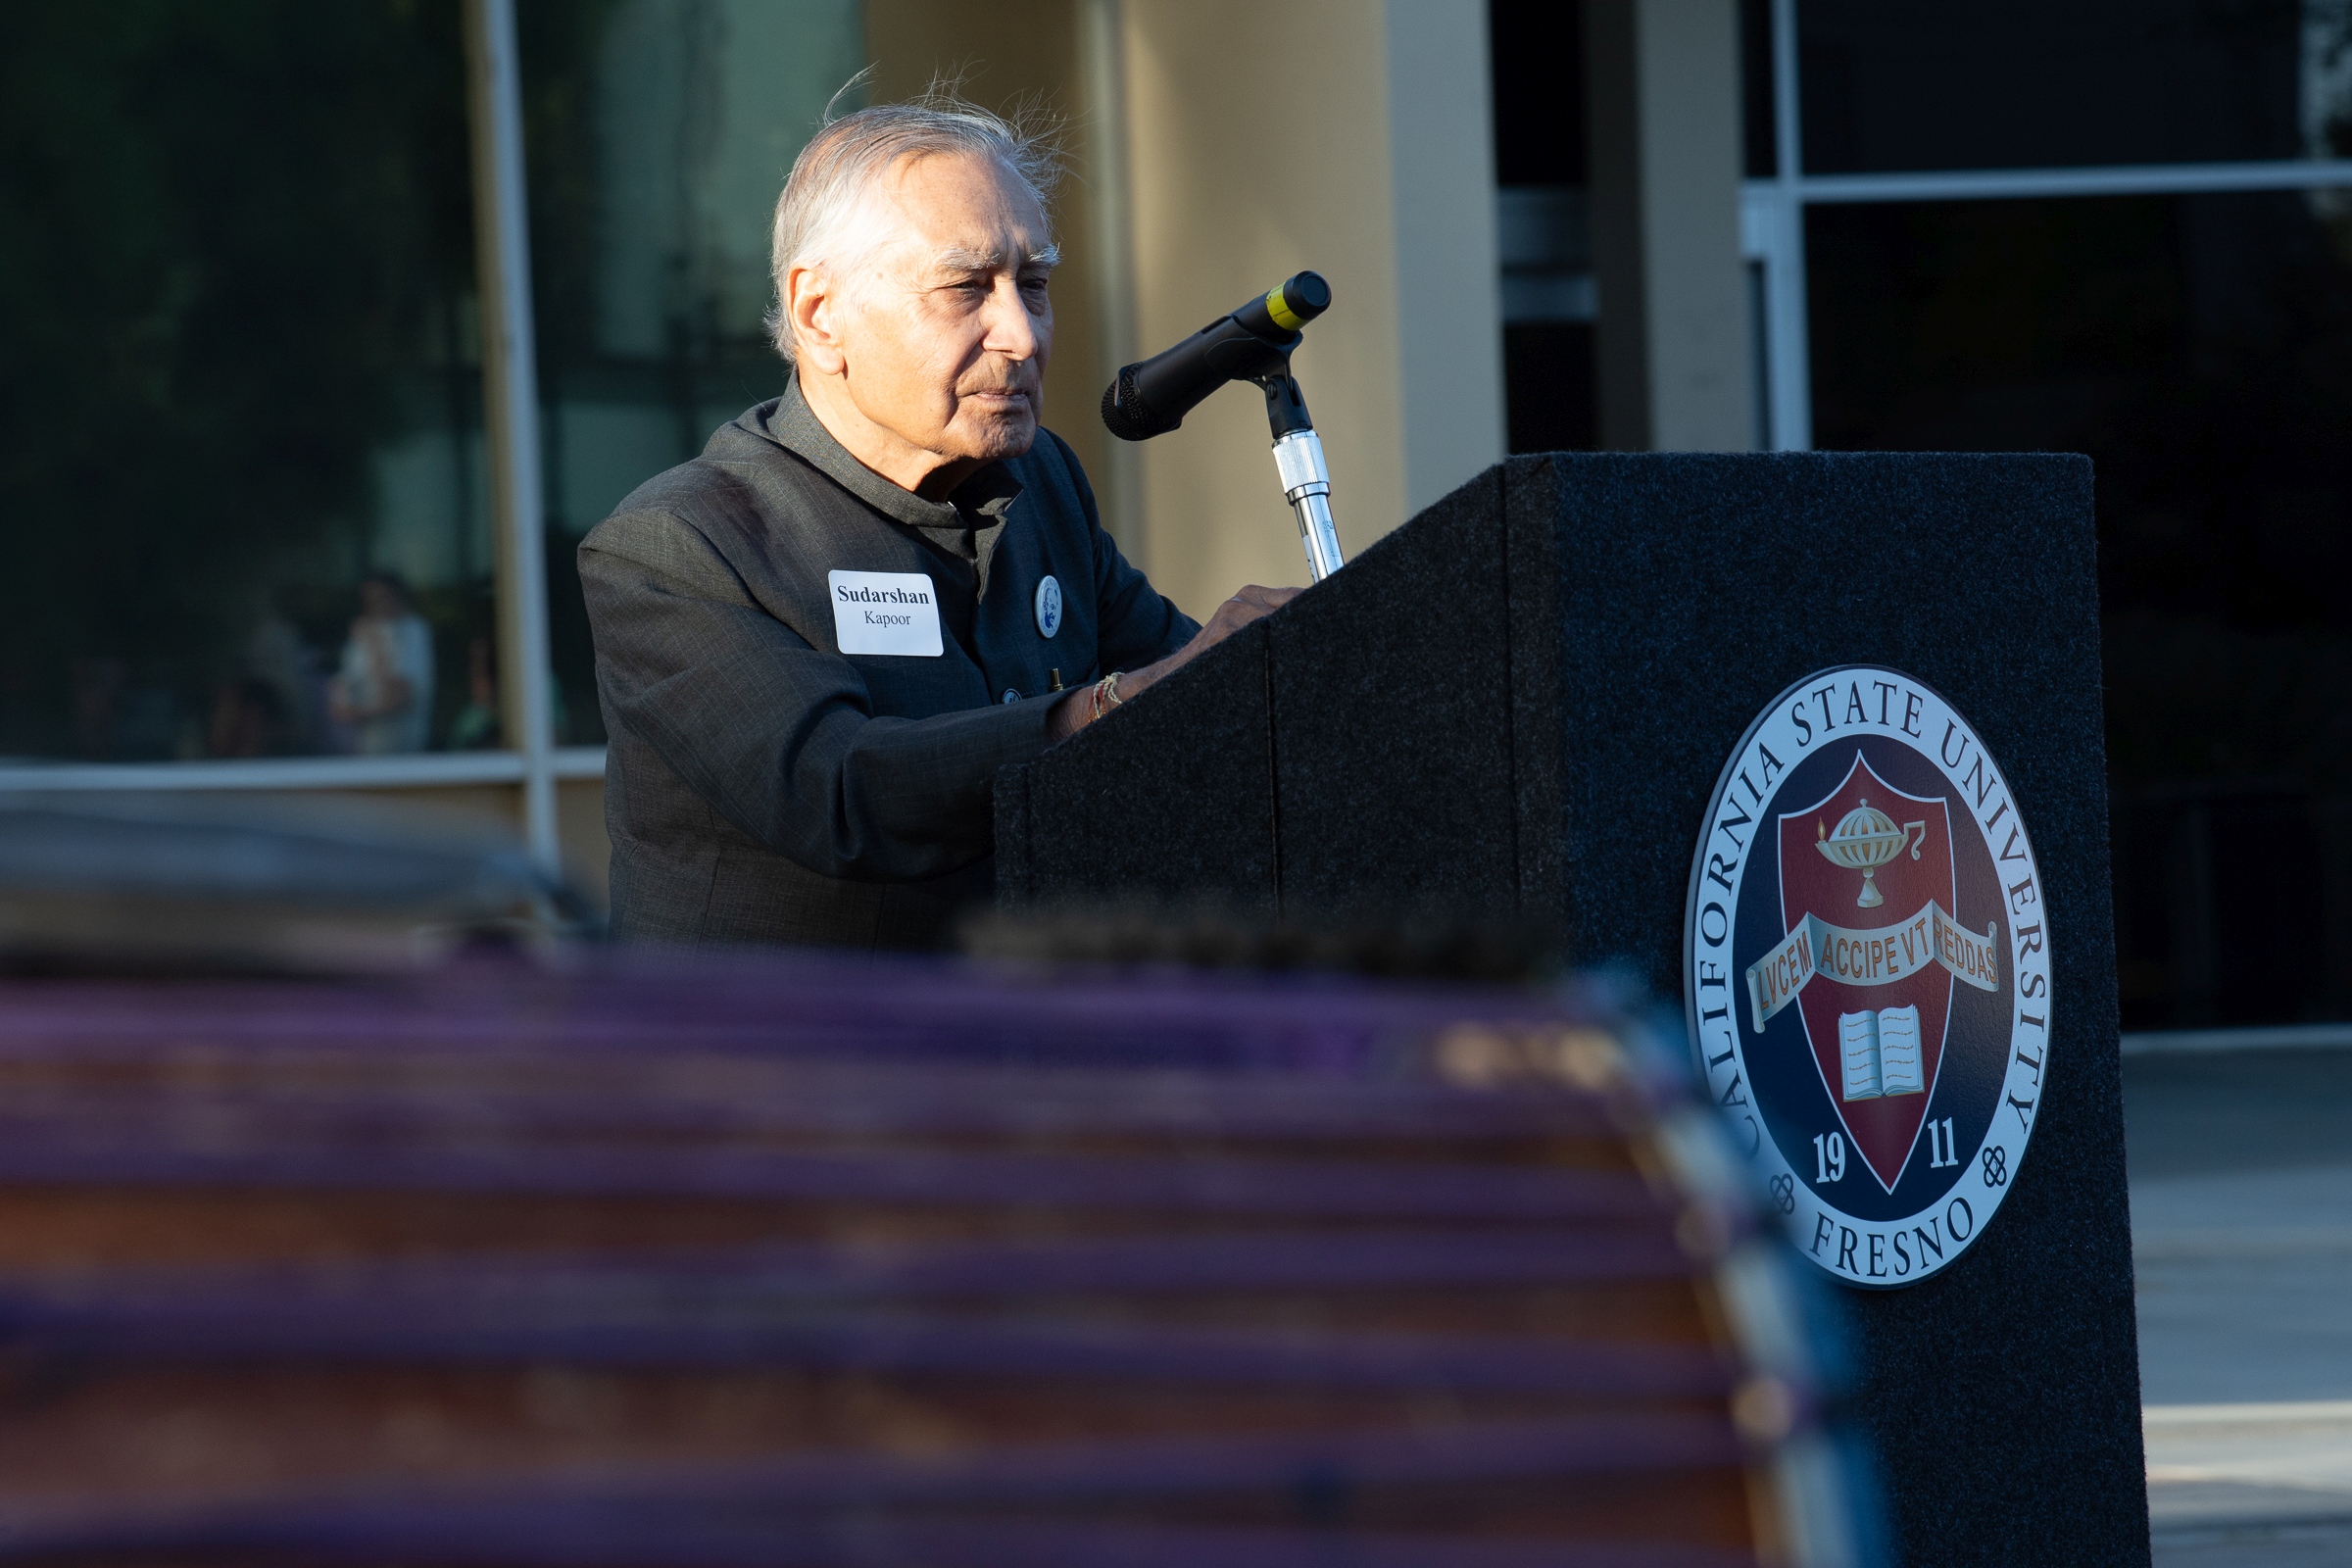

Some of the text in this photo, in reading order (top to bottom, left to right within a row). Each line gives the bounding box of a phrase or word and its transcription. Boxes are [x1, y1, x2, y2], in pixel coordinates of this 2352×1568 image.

[837, 585, 930, 605] Sudarshan
[864, 611, 911, 628] Kapoor
[1699, 680, 2046, 1161] CALIFORNIA STATE UNIVERSITY
[1757, 913, 1997, 1010] LVCEM ACCIPE VT REDDAS
[1813, 1116, 1959, 1184] 19 11
[1809, 1197, 1974, 1278] FRESNO
